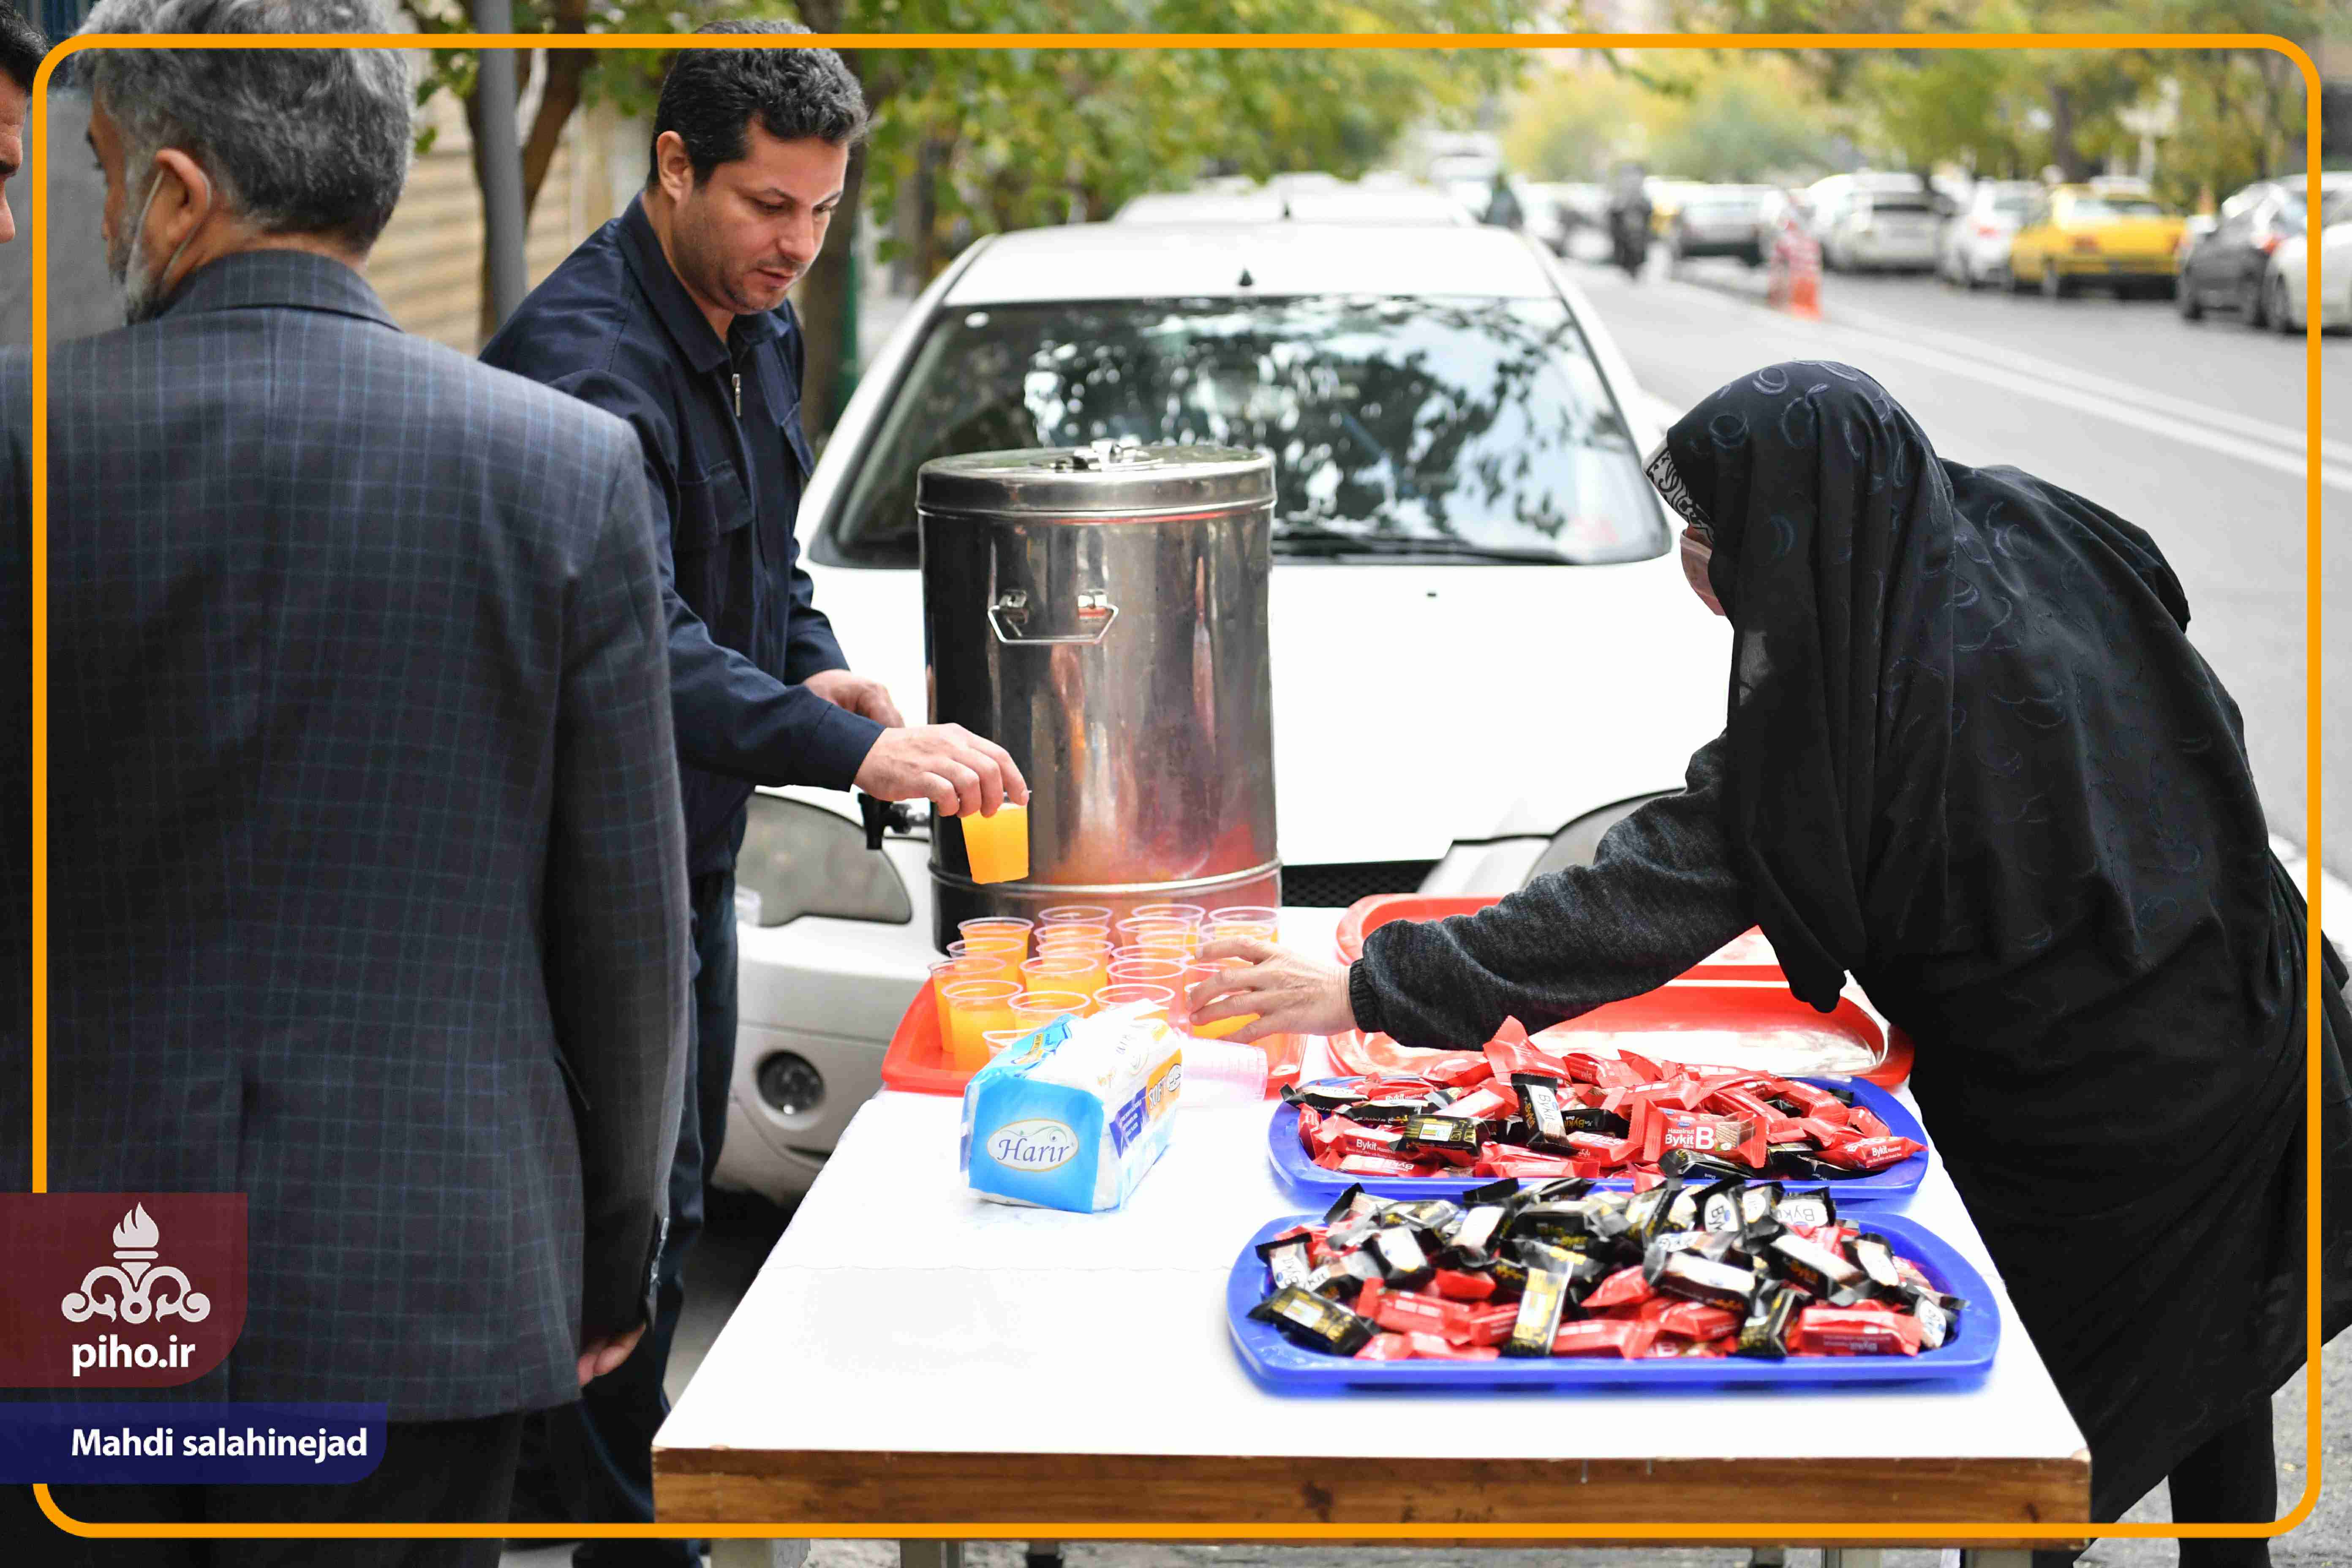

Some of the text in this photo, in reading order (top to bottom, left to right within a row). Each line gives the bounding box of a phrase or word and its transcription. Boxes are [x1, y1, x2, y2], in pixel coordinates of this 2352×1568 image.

[1538, 1094, 1556, 1121] Bykit
[1356, 1138, 1377, 1150] Bykit
[1665, 1126, 1715, 1149] Bykit B
[997, 1138, 1070, 1162] Harir
[1872, 1145, 1888, 1157] Bykit
[1707, 1205, 1725, 1231] Byk
